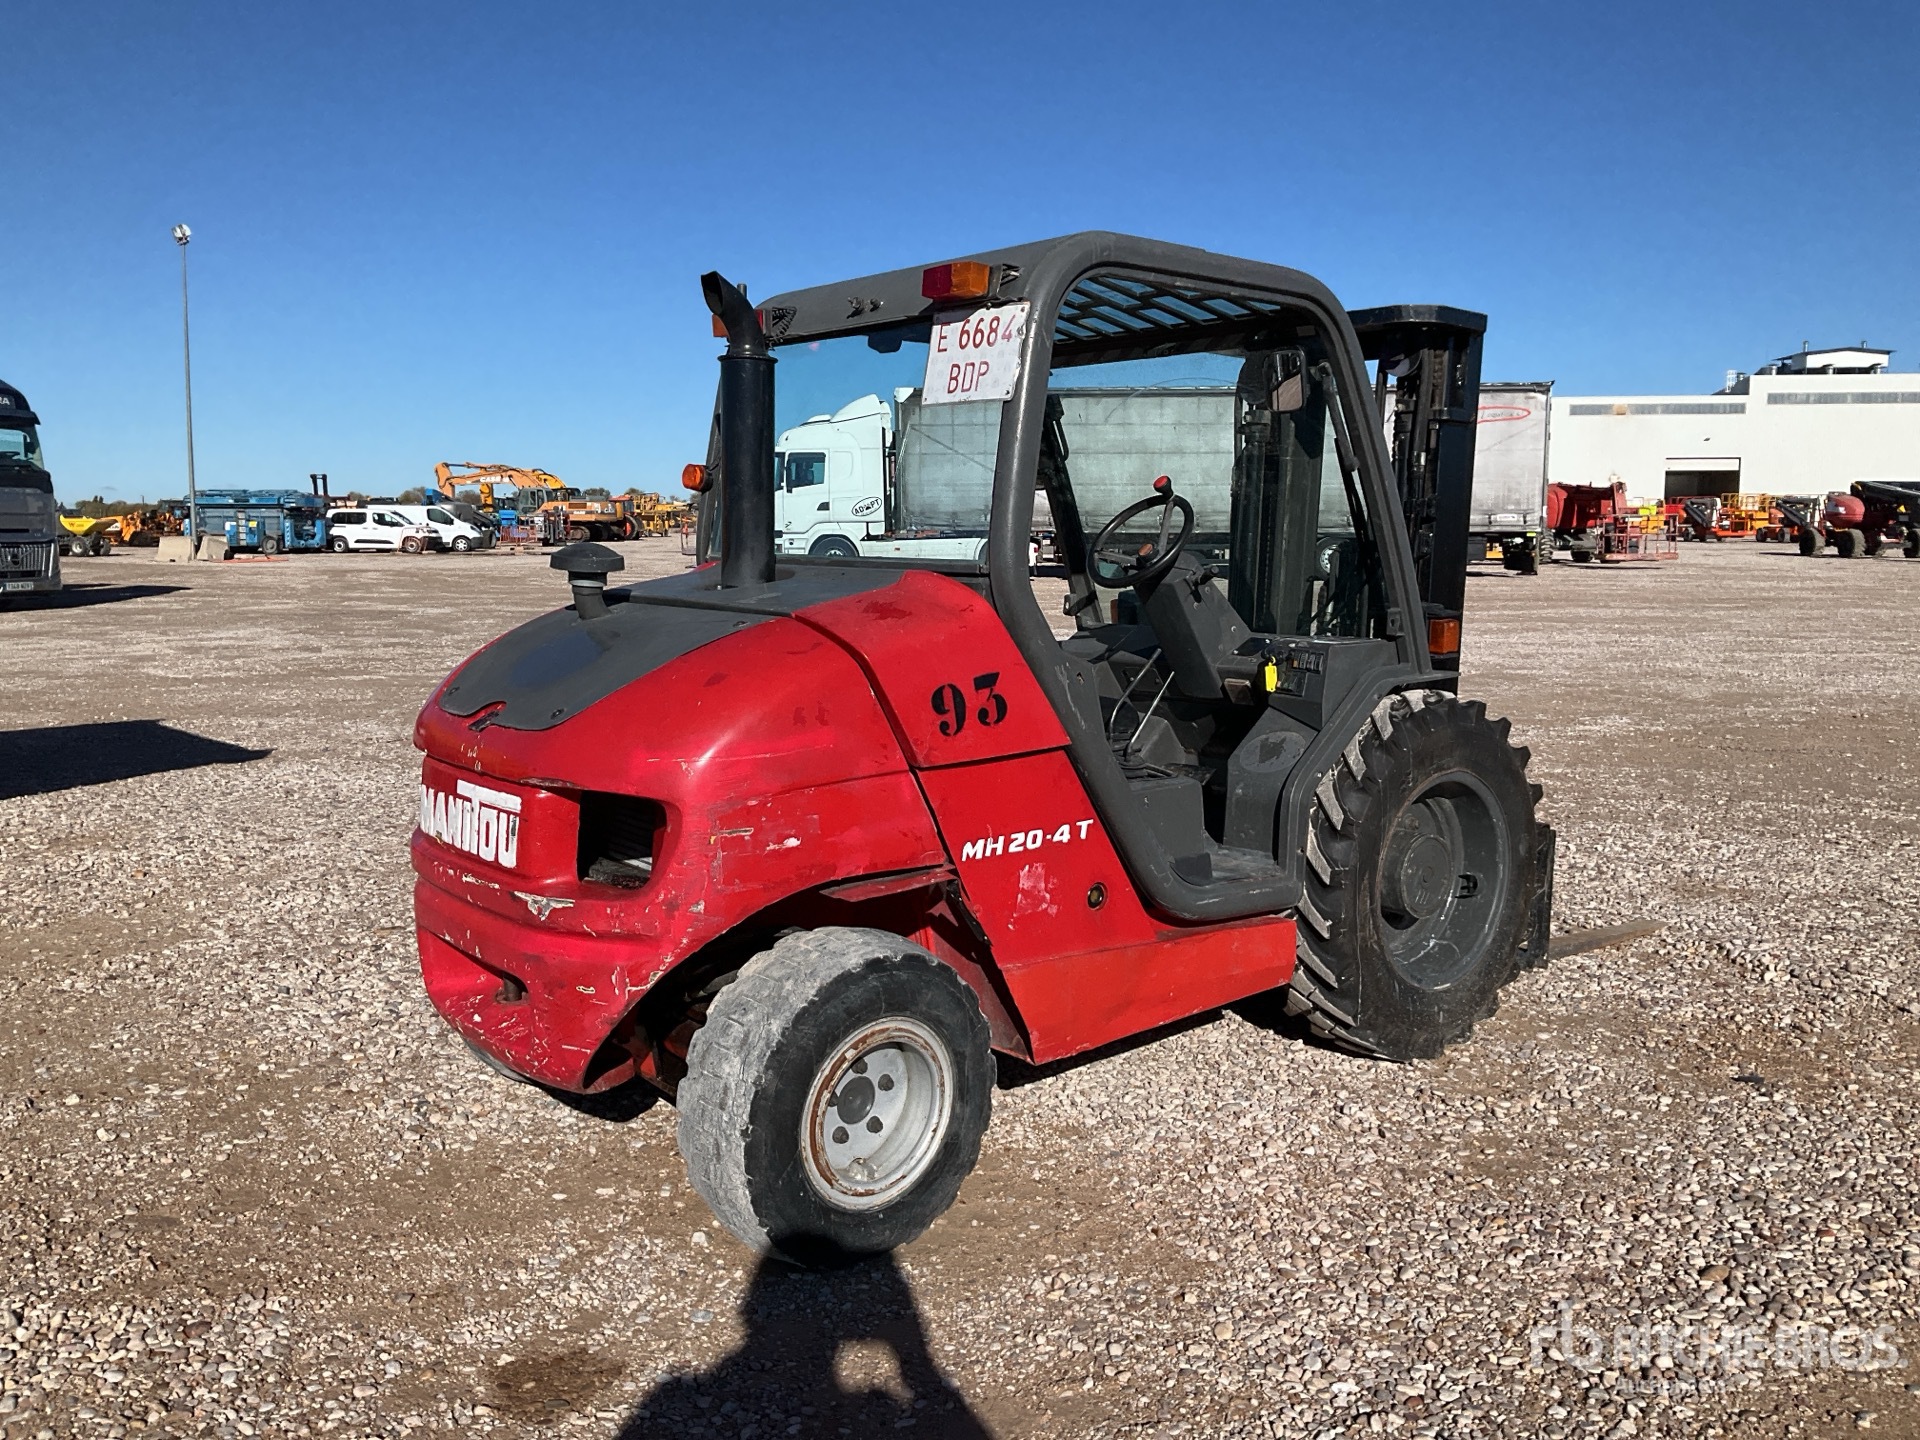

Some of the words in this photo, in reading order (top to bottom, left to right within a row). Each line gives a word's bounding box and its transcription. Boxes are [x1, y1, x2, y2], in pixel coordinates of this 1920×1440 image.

[937, 321, 951, 353] E
[958, 314, 1017, 351] 6684
[946, 360, 990, 395] BDP
[930, 671, 1009, 737] 93
[419, 779, 522, 869] MANITOU
